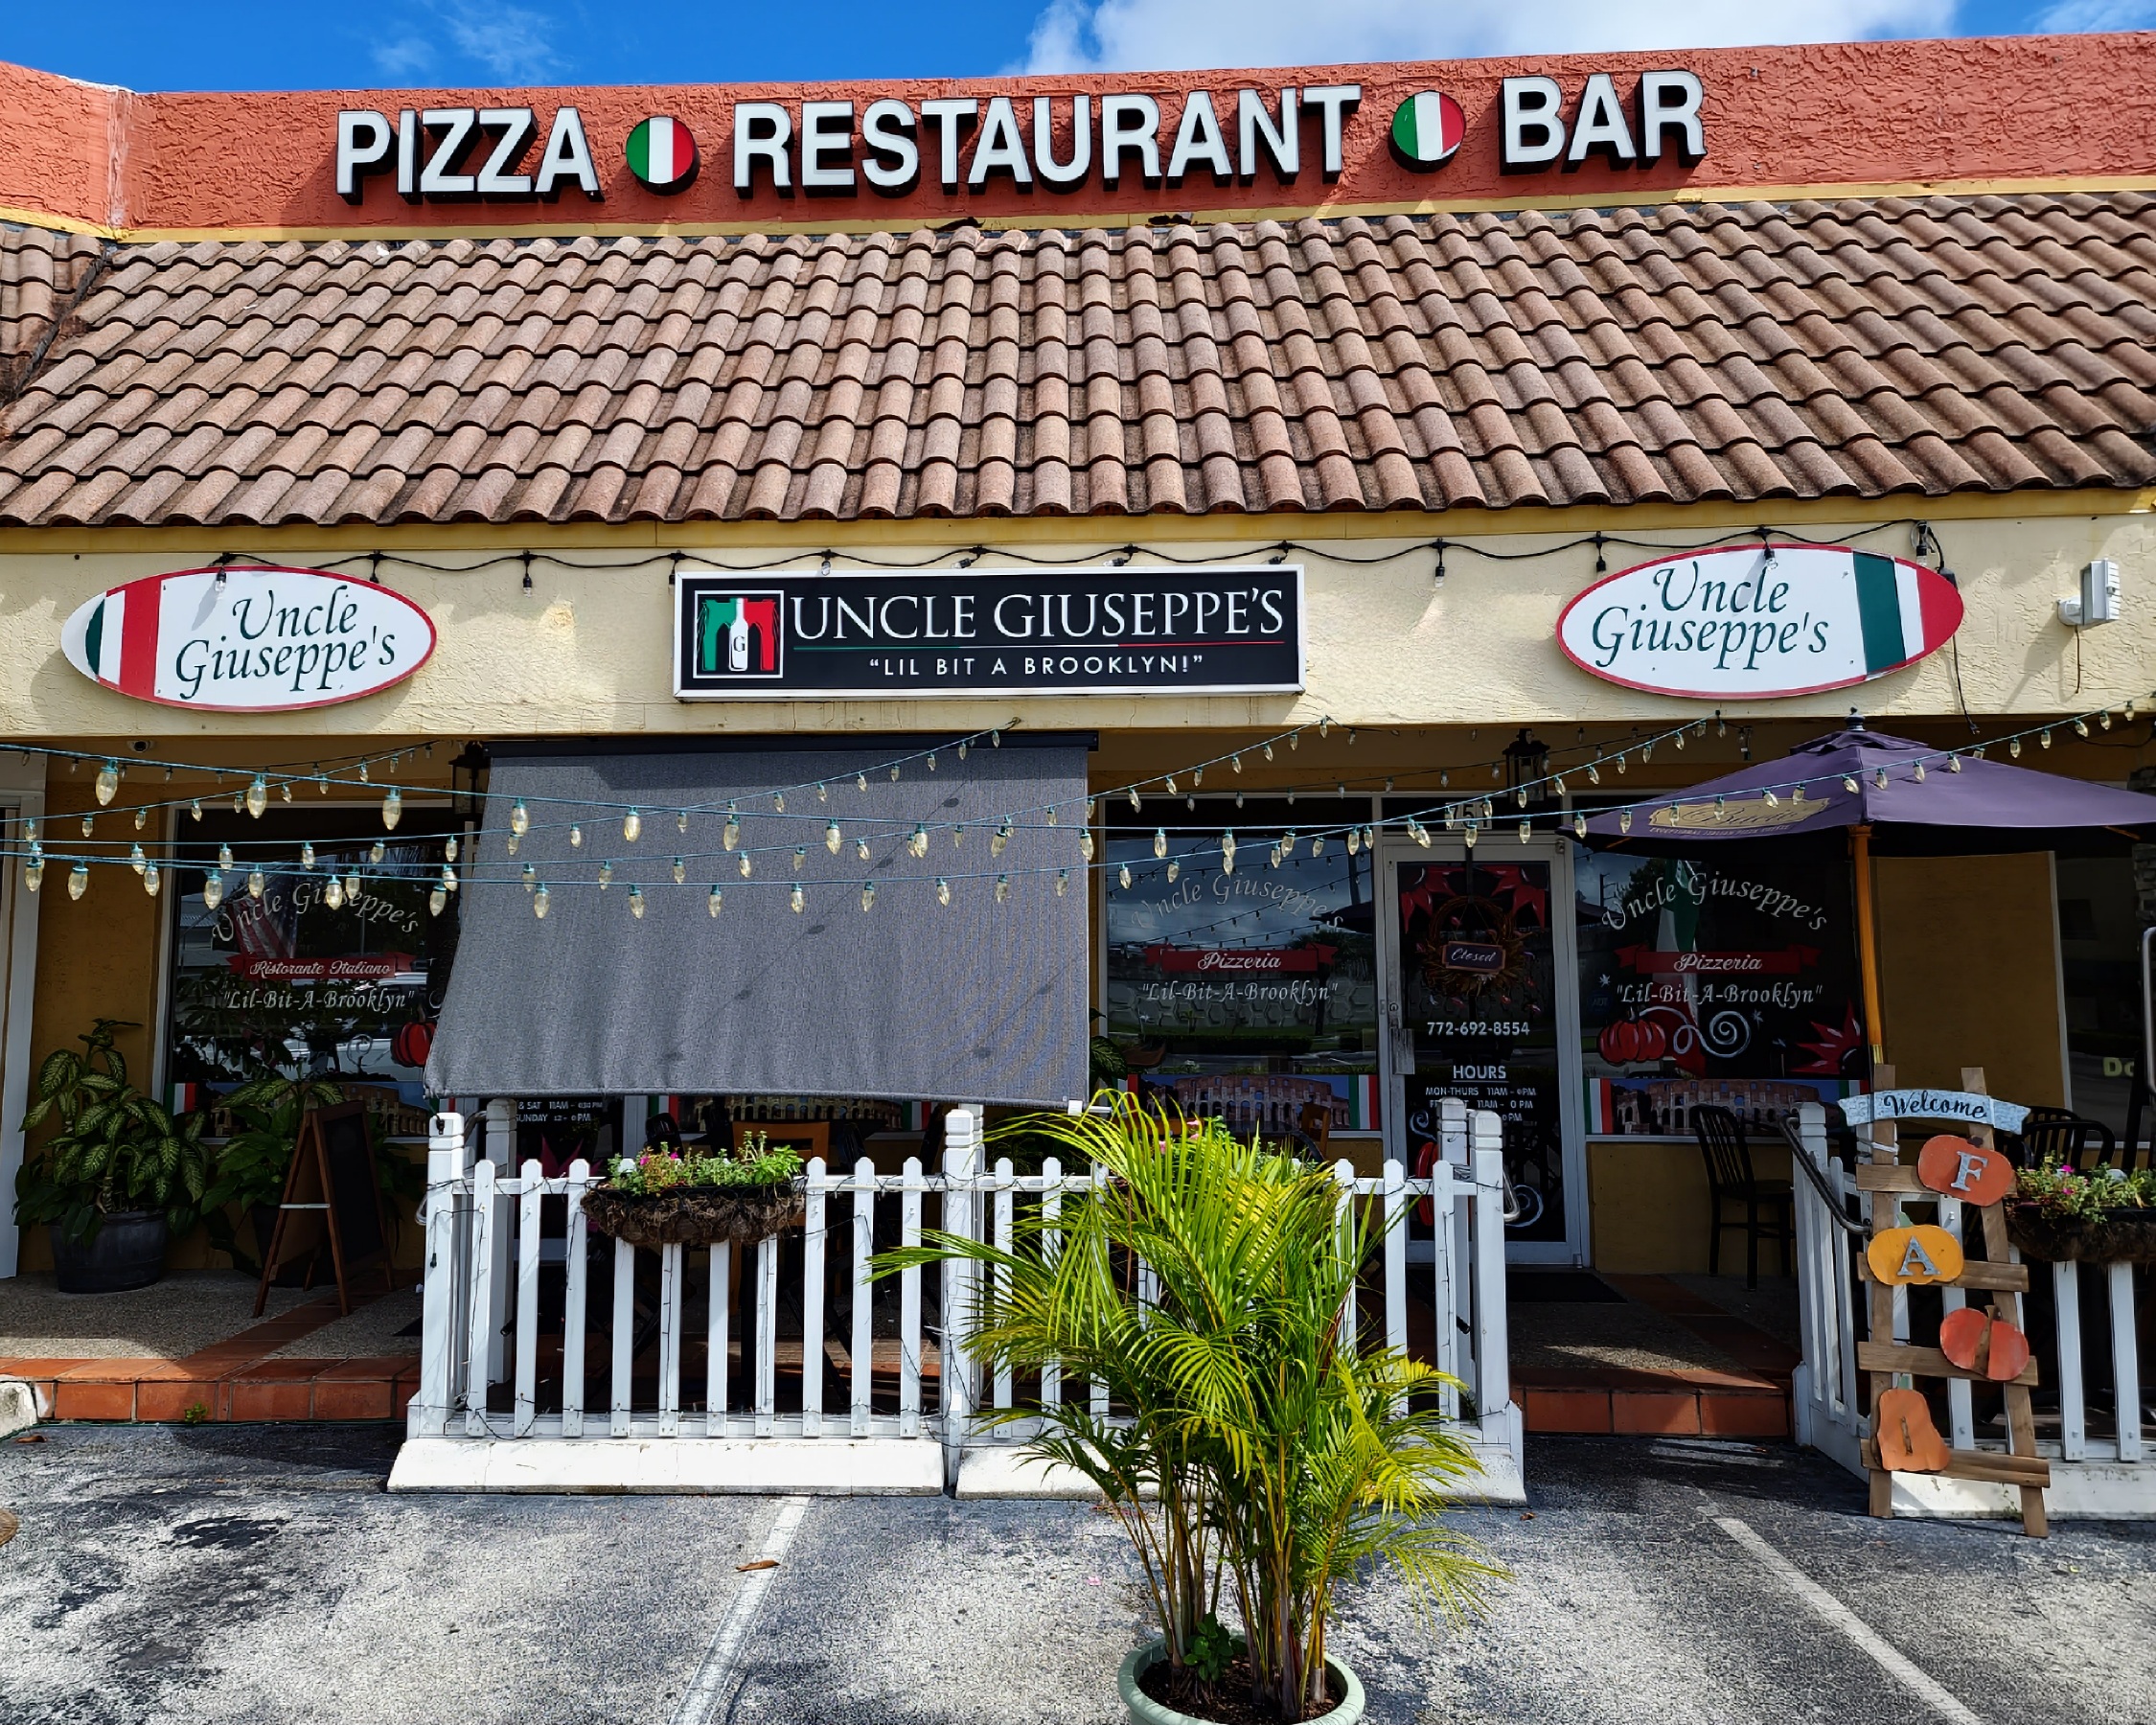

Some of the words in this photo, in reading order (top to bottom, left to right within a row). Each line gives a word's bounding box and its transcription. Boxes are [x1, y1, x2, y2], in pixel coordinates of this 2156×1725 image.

[336, 105, 602, 197] PIZZA
[733, 82, 1362, 193] RESTAURANT
[1501, 68, 1707, 169] BAR
[1652, 561, 1789, 614] Uncle
[232, 584, 358, 640] Uncle
[791, 595, 975, 640] UNCLE
[993, 587, 1284, 638] GIUSEPPE'S
[733, 635, 745, 652] G
[1591, 606, 1829, 671] Giuseppe's
[175, 626, 396, 700] Giuseppe's
[869, 658, 919, 676] “LIL
[936, 657, 974, 675] BIT
[992, 657, 1008, 674] A
[1027, 655, 1204, 675] BROOKLYN!”
[213, 888, 283, 942] Uncle
[292, 883, 420, 933] Giseppe's
[1131, 877, 1202, 929] Uncle
[1601, 877, 1677, 930] Uncle
[1687, 870, 1827, 931] Giuseppe's
[1197, 951, 1282, 971] Pizzeria
[1451, 947, 1498, 962] Closed
[1673, 953, 1763, 972] Pizzeria
[250, 960, 326, 978] Ristorante
[329, 959, 391, 976] Italiano
[224, 989, 415, 1013] "Lil-Bit-A-Brooklyn"
[1142, 979, 1338, 1005] "Lil-Bit-A-Brooklyn"
[1617, 982, 1823, 1008] "Lil-Bit-A-Brooklyn"
[1427, 1022, 1530, 1036] 772-692-8554
[1453, 1065, 1506, 1079] HOURS
[1425, 1087, 1479, 1096] MON-THURS
[1486, 1087, 1508, 1096] 11AM
[1883, 1090, 1987, 1119] Welcome
[526, 1101, 542, 1110] SAT
[1950, 1150, 1988, 1192] F
[1897, 1235, 1941, 1276] A
